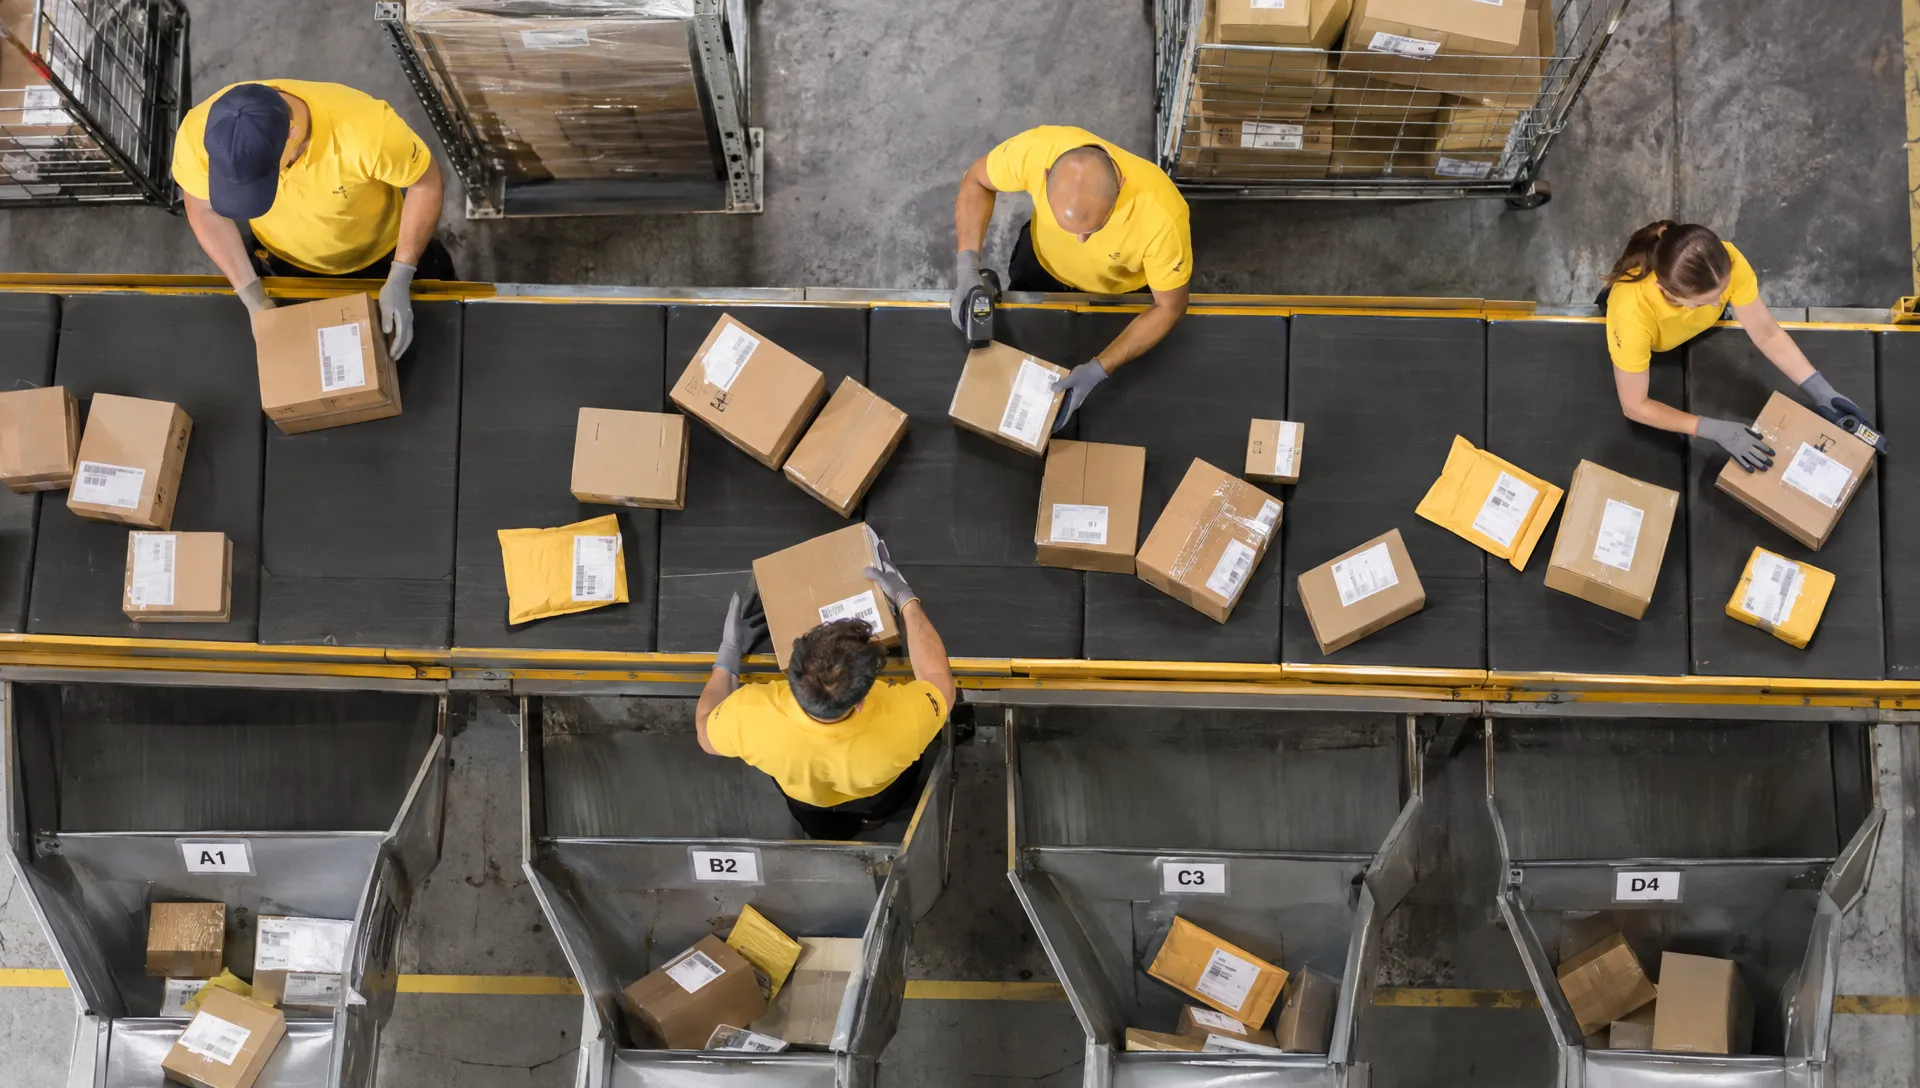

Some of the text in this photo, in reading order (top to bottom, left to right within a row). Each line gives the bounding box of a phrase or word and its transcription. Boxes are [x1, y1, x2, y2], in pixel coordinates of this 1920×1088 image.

[199, 850, 226, 865] A1
[709, 858, 738, 873] B2
[1177, 870, 1205, 886] C3
[1631, 877, 1660, 892] D4
